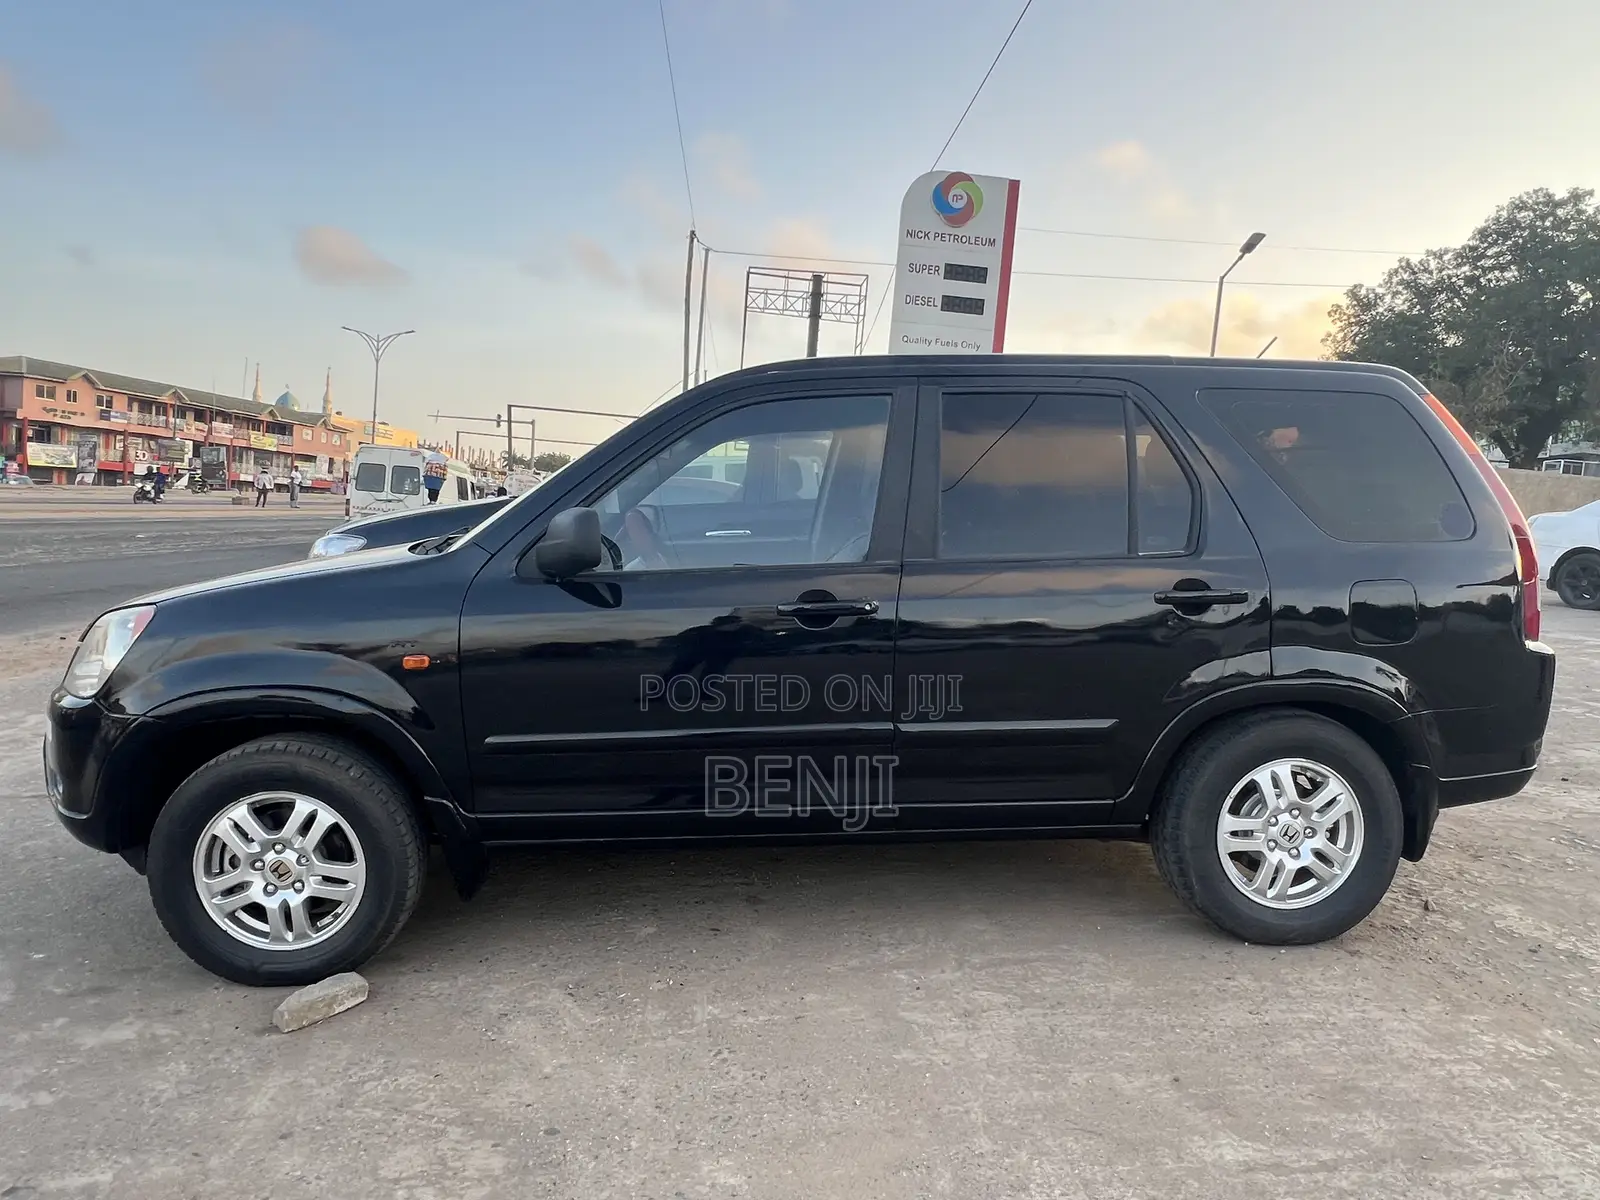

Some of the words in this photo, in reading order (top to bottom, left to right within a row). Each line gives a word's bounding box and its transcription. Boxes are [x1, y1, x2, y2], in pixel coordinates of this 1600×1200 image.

[906, 229, 931, 240] NICK
[933, 232, 996, 247] PETROLEUM
[908, 263, 940, 276] SUPER
[905, 294, 938, 308] DIESEL
[901, 335, 932, 347] Quality
[935, 338, 958, 348] Fuels
[961, 341, 981, 352] Only
